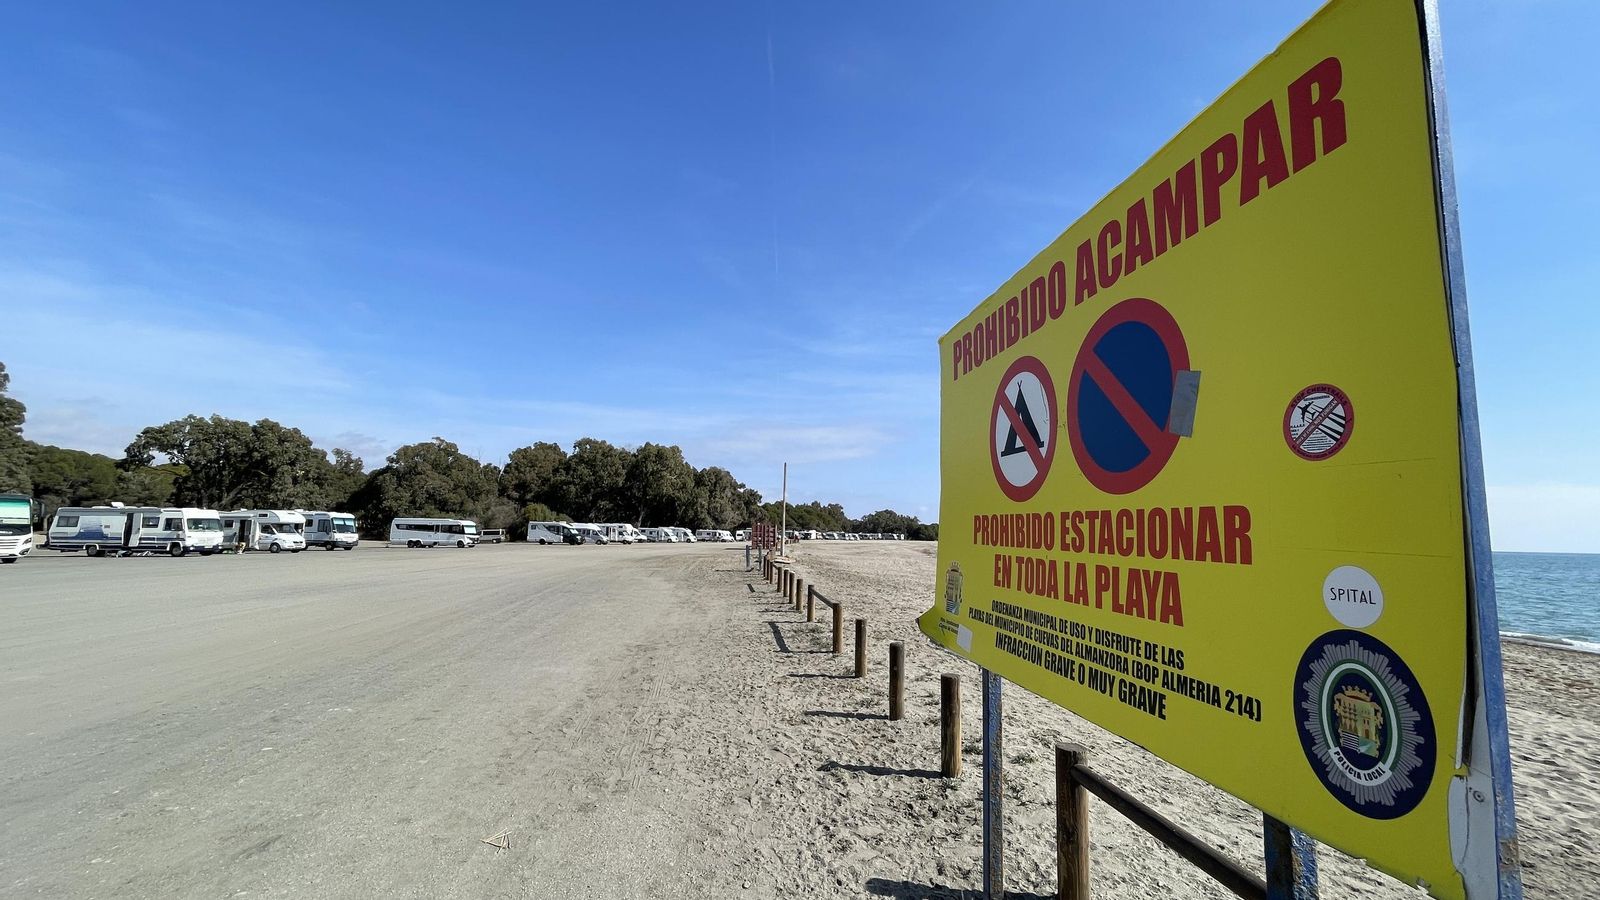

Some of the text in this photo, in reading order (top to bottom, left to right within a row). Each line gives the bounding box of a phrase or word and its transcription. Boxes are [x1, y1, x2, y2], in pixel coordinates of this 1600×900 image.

[953, 56, 1348, 381] PROHIBIDO ACAMPAR
[973, 505, 1252, 565] PROHIBIDO ESTACIONAR
[994, 553, 1184, 627] EN TODA LA PLAYA
[1330, 587, 1376, 605] SPITAL
[968, 607, 985, 623] PLAYAS
[985, 611, 994, 626] DEL
[994, 614, 1025, 637] MUNICIPIO
[1025, 625, 1033, 640] DE
[1034, 628, 1059, 650] CUEVAS
[1060, 635, 1073, 655] DEL
[1074, 641, 1129, 675] ALMANZORA
[1131, 660, 1159, 685] (BOP
[1161, 669, 1222, 709] ALMERIA
[1224, 689, 1262, 722] 214)
[991, 600, 1185, 671] ORDENANZA MUNICIPAL DE USO Y DISFRUTE DE LAS
[995, 631, 1167, 721] INFRACCION GRAVE O MUY GRAVE
[1333, 751, 1386, 781] POLICIA LOCAL
